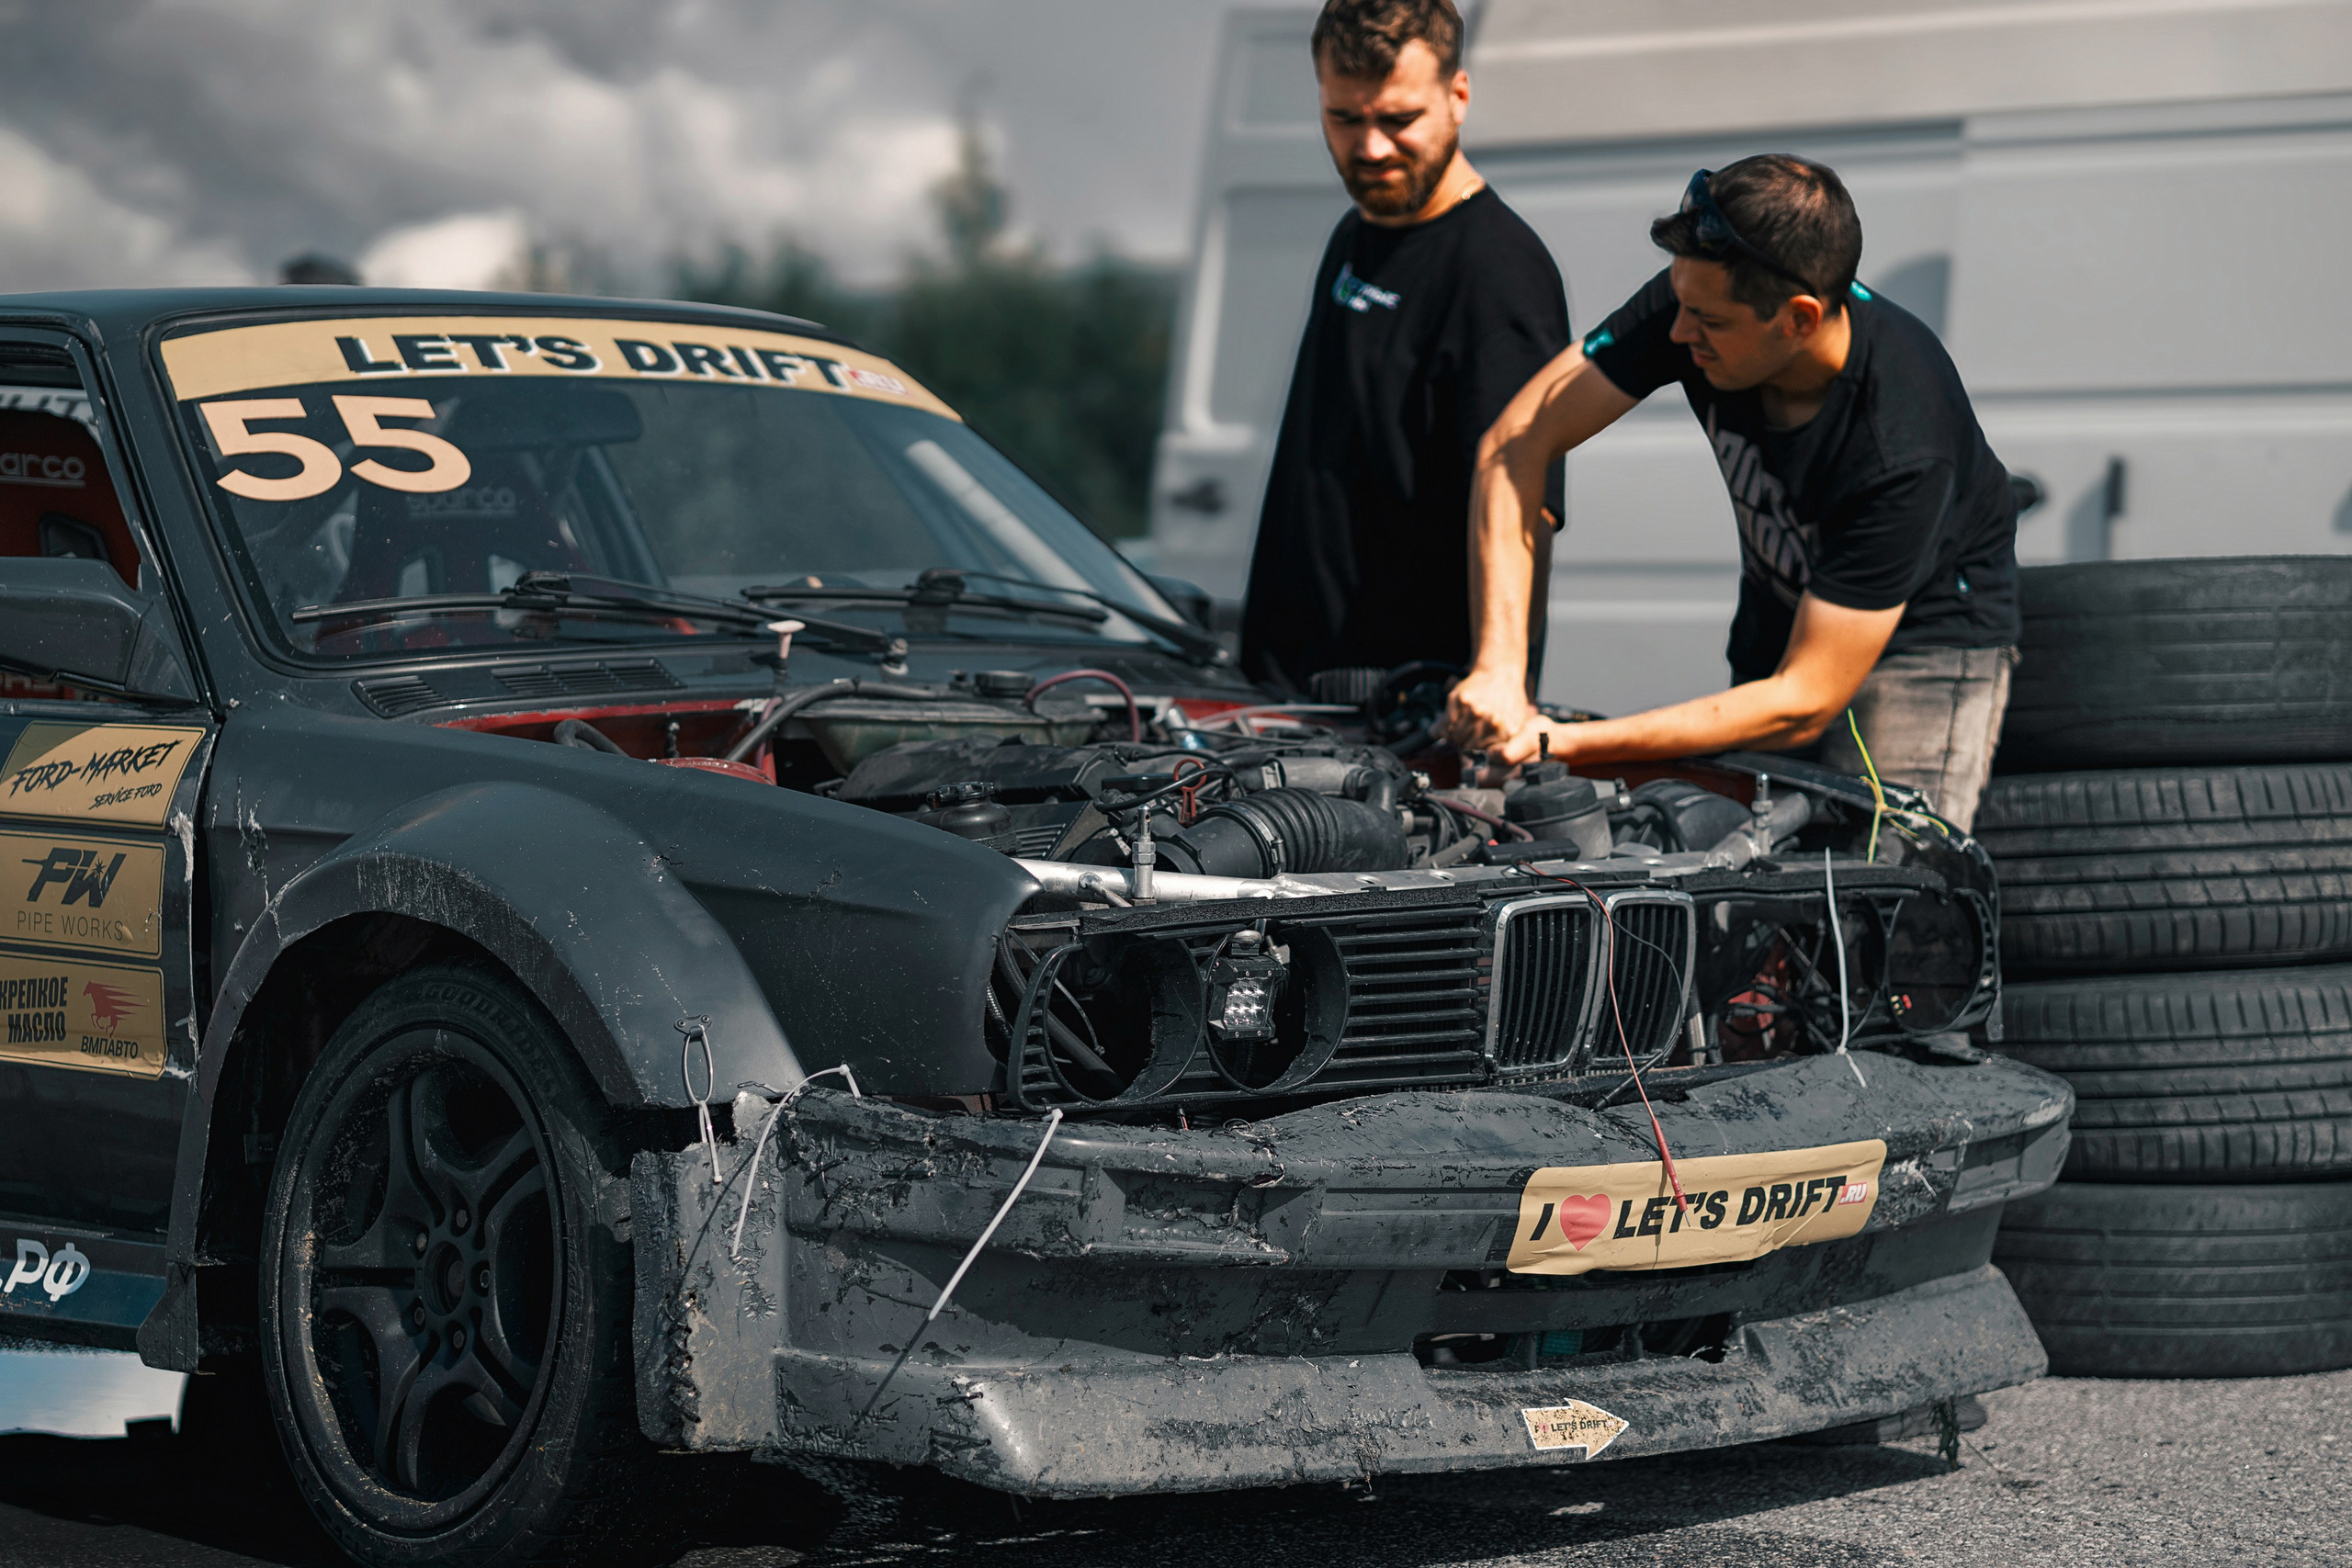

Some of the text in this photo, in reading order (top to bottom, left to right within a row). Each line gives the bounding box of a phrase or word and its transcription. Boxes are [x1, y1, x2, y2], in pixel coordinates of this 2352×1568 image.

[335, 334, 603, 376] LET'S
[199, 394, 471, 502] 55
[8, 739, 185, 799] FORD-MARKET
[133, 783, 163, 800] FORD
[17, 910, 124, 942] PIPE WORKS
[7, 1010, 67, 1043] МАСЛО
[80, 1035, 139, 1059] ВМПАВТО
[1529, 1202, 1555, 1241] I
[1611, 1190, 1728, 1240] LET'S
[1550, 1421, 1577, 1432] LET'S
